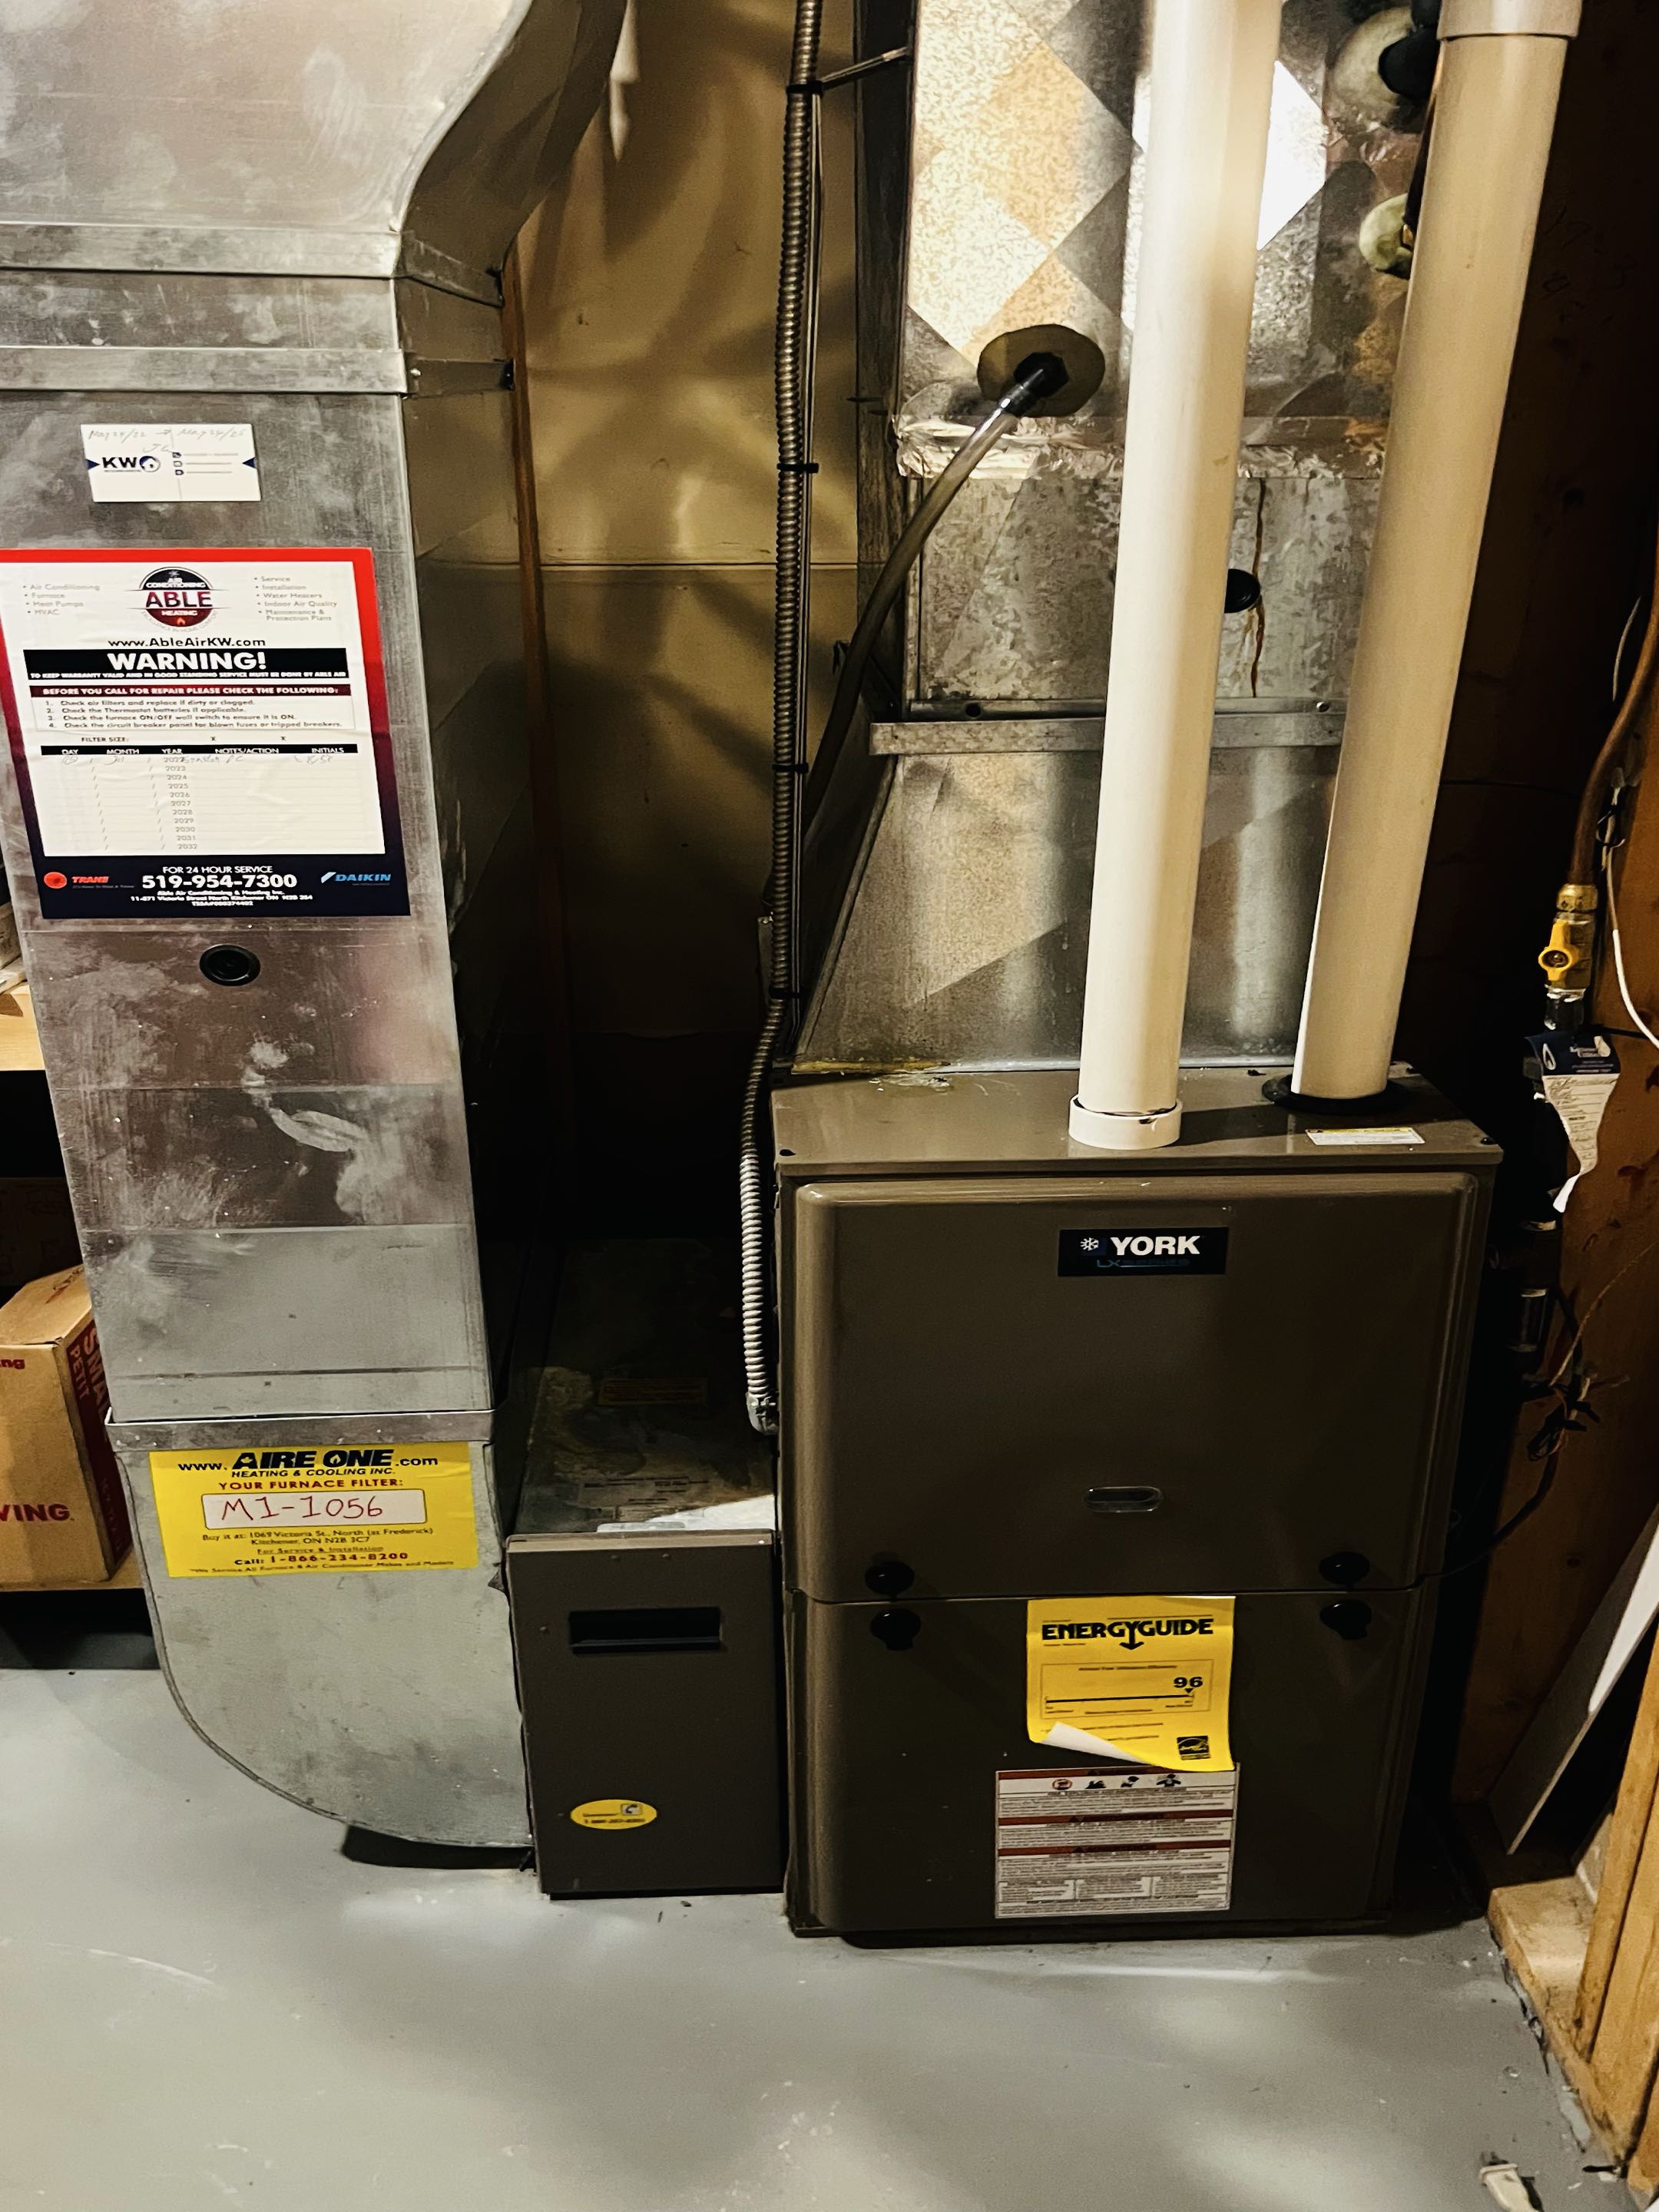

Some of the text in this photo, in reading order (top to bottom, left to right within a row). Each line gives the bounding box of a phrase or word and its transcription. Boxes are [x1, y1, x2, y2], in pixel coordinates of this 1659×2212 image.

[145, 591, 213, 608] ABLE
[108, 637, 266, 648] www.AbleAirKW.com
[107, 651, 267, 671] WARNING!
[142, 874, 297, 889] 519-954-7300
[335, 873, 391, 882] DAIKIN
[1110, 1235, 1201, 1256] YORK
[232, 1450, 316, 1469] AIRE
[323, 1449, 394, 1468] ONE
[306, 1468, 366, 1476] COOLING
[219, 1479, 402, 1490] YOUR FURNACE FILTER:
[271, 1552, 408, 1563] 1-866-234-8200
[1042, 1618, 1214, 1648] ENERGYGUIDE
[1174, 1676, 1204, 1688] 96
